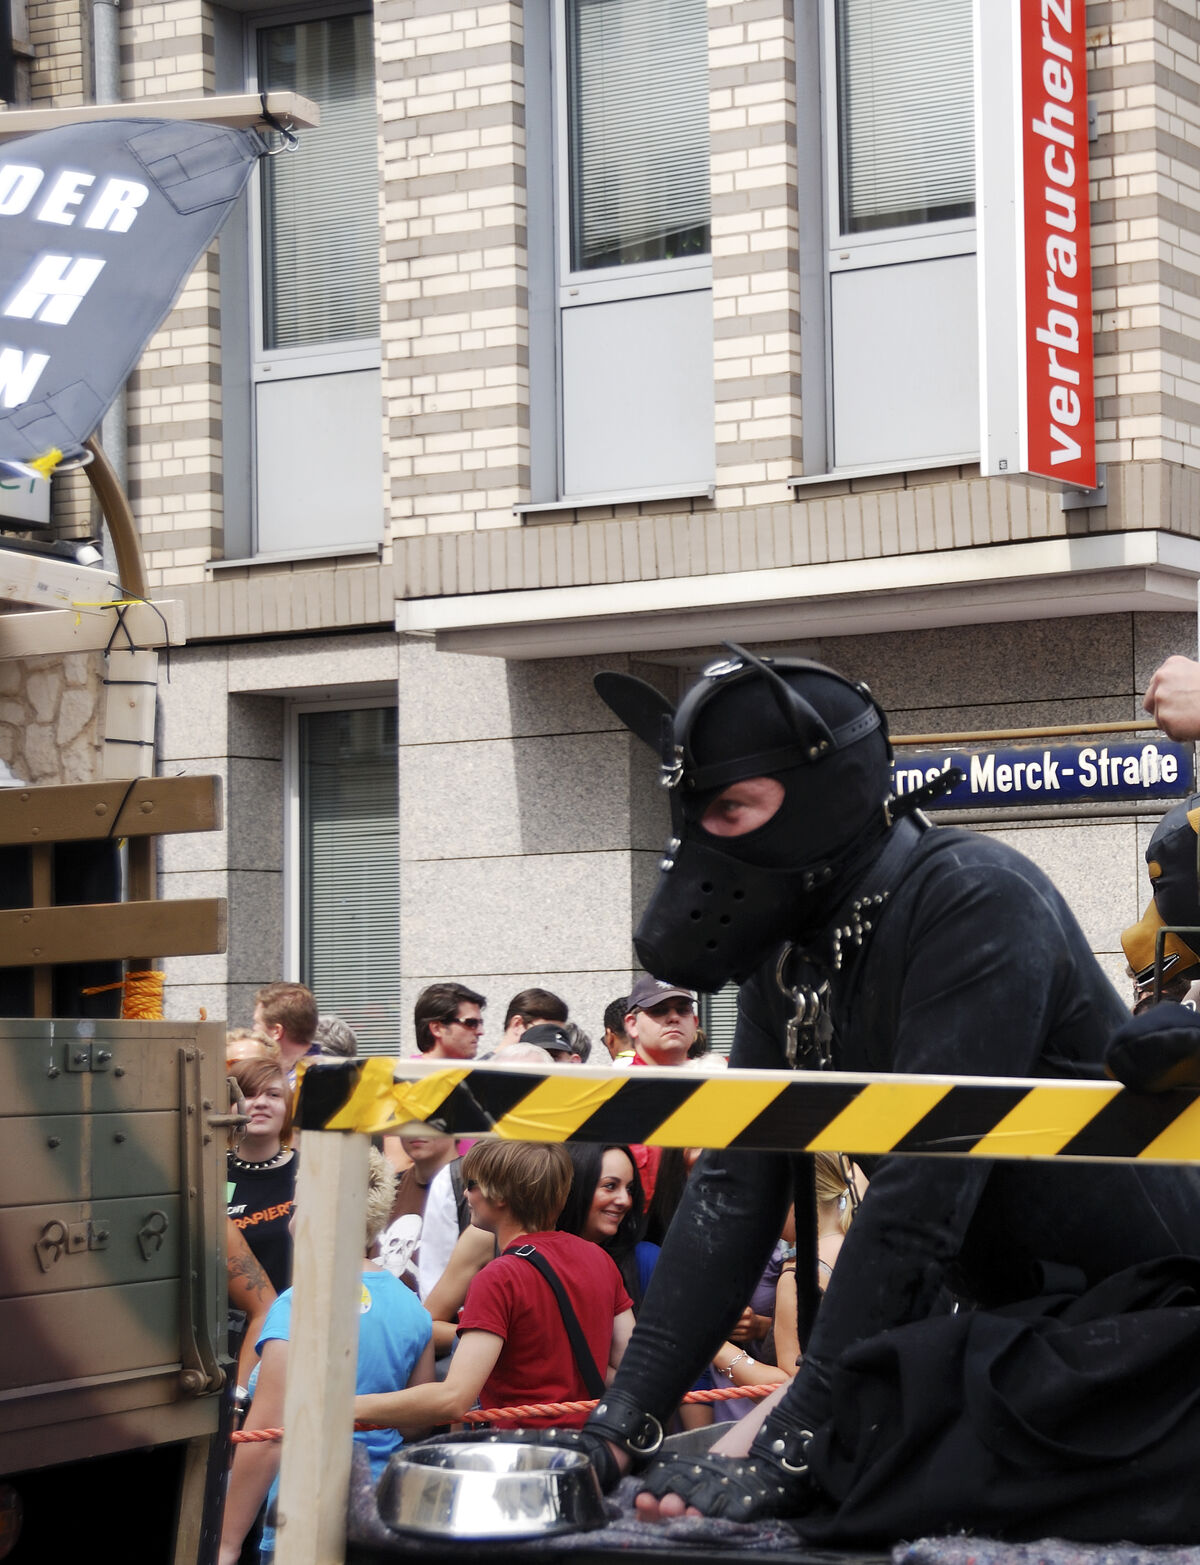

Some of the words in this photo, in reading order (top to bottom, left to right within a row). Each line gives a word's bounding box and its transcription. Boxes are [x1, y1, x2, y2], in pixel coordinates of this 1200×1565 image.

[0, 164, 150, 233] DER
[1032, 0, 1081, 467] verbraucherz
[4, 255, 107, 326] H
[890, 744, 1178, 796] rn-Merck-Straße
